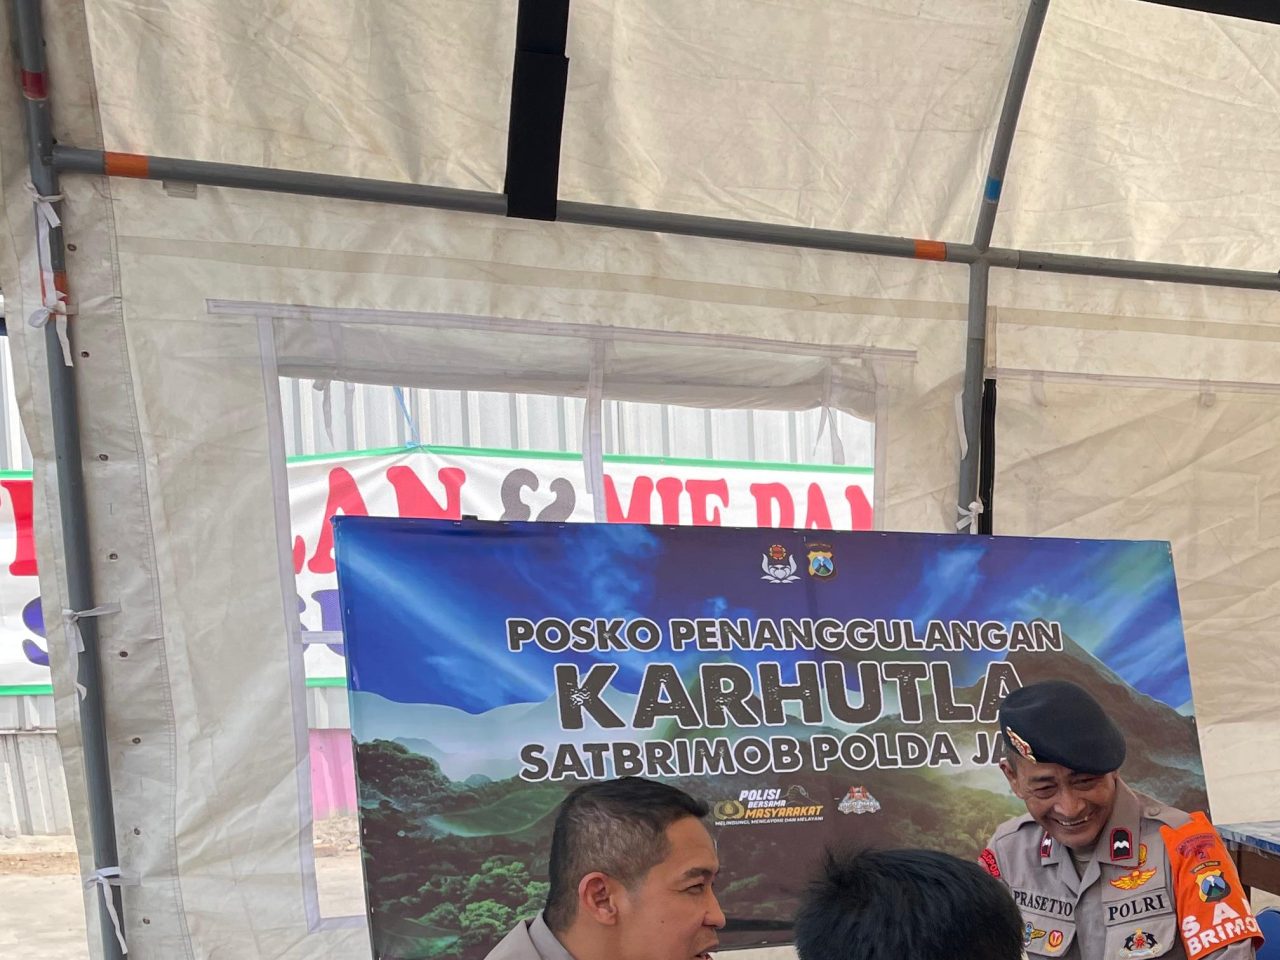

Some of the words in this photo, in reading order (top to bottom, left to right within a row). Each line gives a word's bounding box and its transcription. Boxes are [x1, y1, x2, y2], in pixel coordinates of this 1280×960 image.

[506, 617, 662, 652] POSKO
[669, 617, 1063, 652] PENANGGULANGAN
[554, 661, 1023, 730] KARHUTLA
[519, 736, 802, 782] SATBRIMOB
[811, 732, 961, 771] POLDA
[739, 788, 782, 801] POLISI
[747, 800, 786, 809] BERSAMA
[744, 805, 824, 819] MASYARAKAT
[1014, 889, 1073, 917] PRASETYO
[1108, 894, 1165, 921] POLRI
